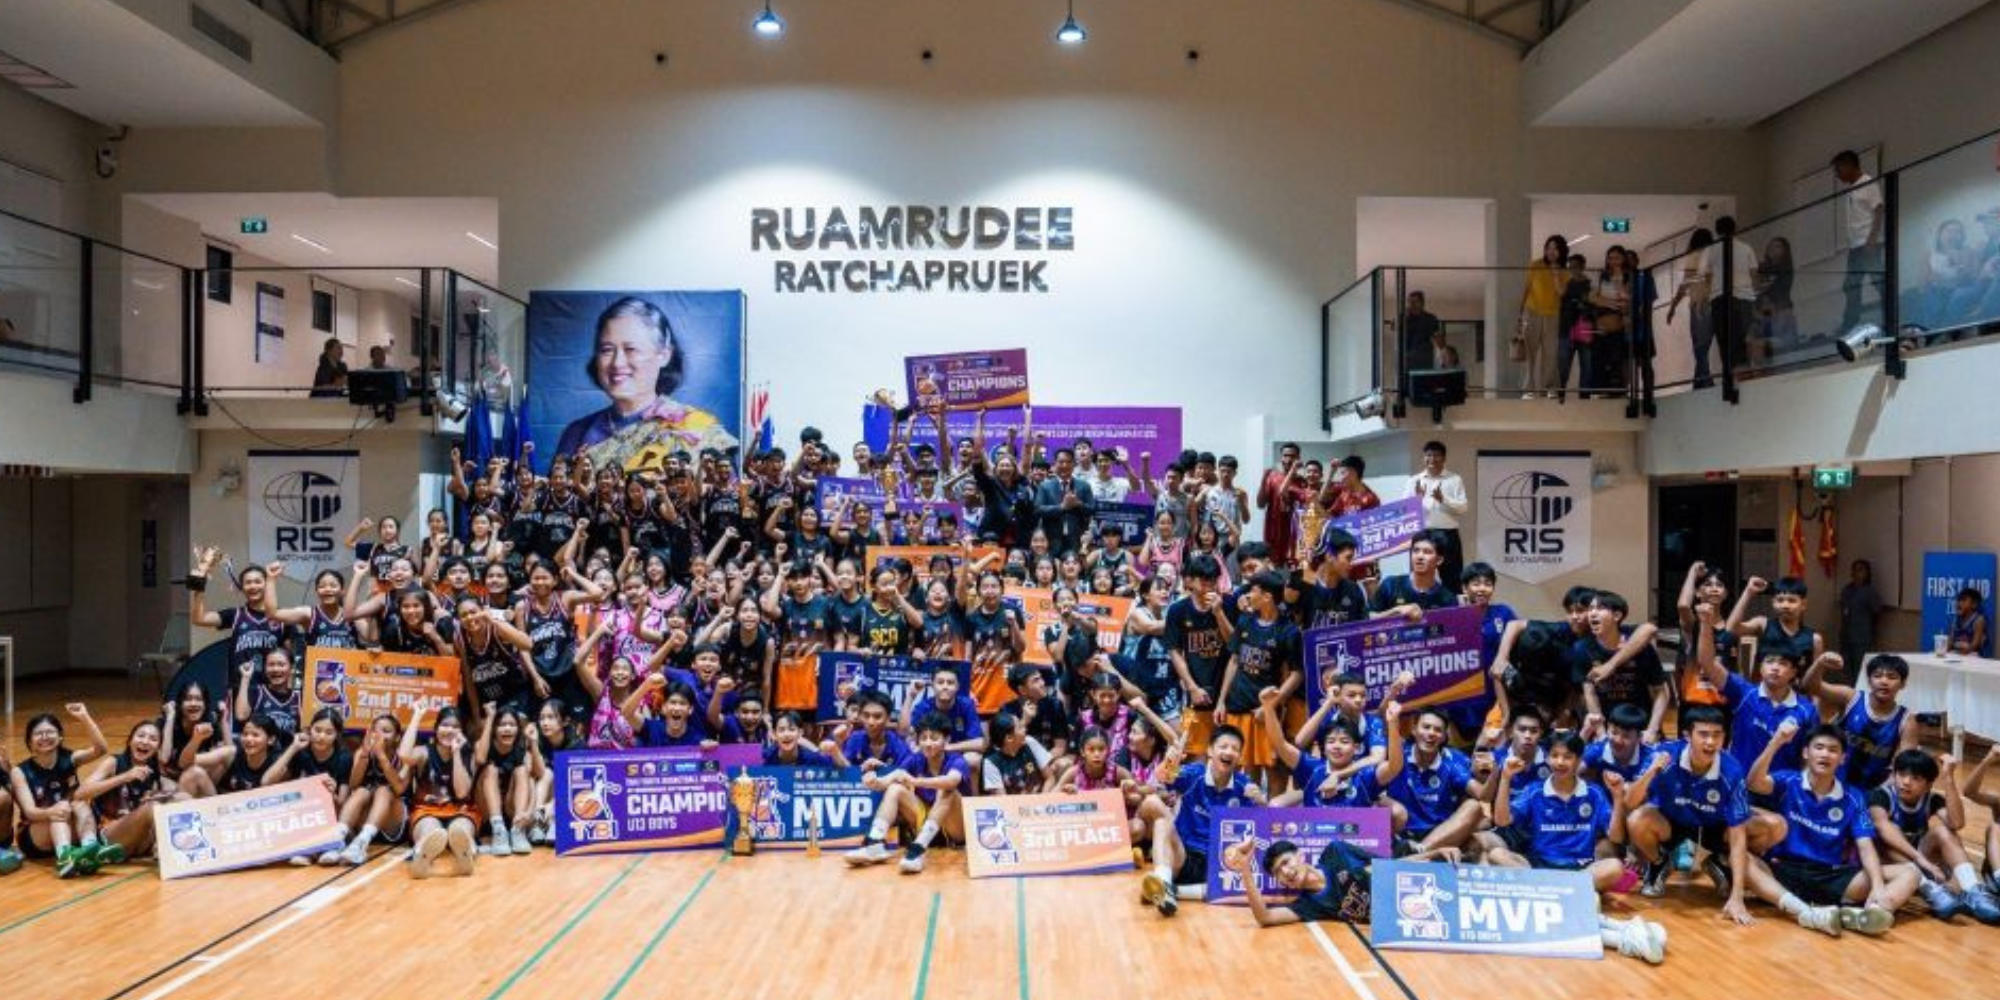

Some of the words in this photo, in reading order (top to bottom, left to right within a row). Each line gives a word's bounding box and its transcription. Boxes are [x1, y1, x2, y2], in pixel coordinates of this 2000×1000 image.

[751, 206, 1075, 251] RUAMRUDEE
[775, 260, 1048, 293] RATCHAPRUEK
[948, 375, 1026, 391] CHAMPIONS
[277, 526, 334, 552] RIS
[1383, 520, 1420, 541] PLACE
[1505, 528, 1564, 554] RIS
[1928, 577, 1963, 598] FIRST
[1365, 649, 1480, 686] CHAMPIONS
[357, 690, 391, 708] 2nd
[396, 691, 453, 712] PLCE
[261, 811, 328, 838] PLACE
[649, 817, 677, 831] BOYS
[793, 796, 873, 828] MVP
[1061, 825, 1122, 846] PLACE
[1458, 896, 1563, 933] MVP
